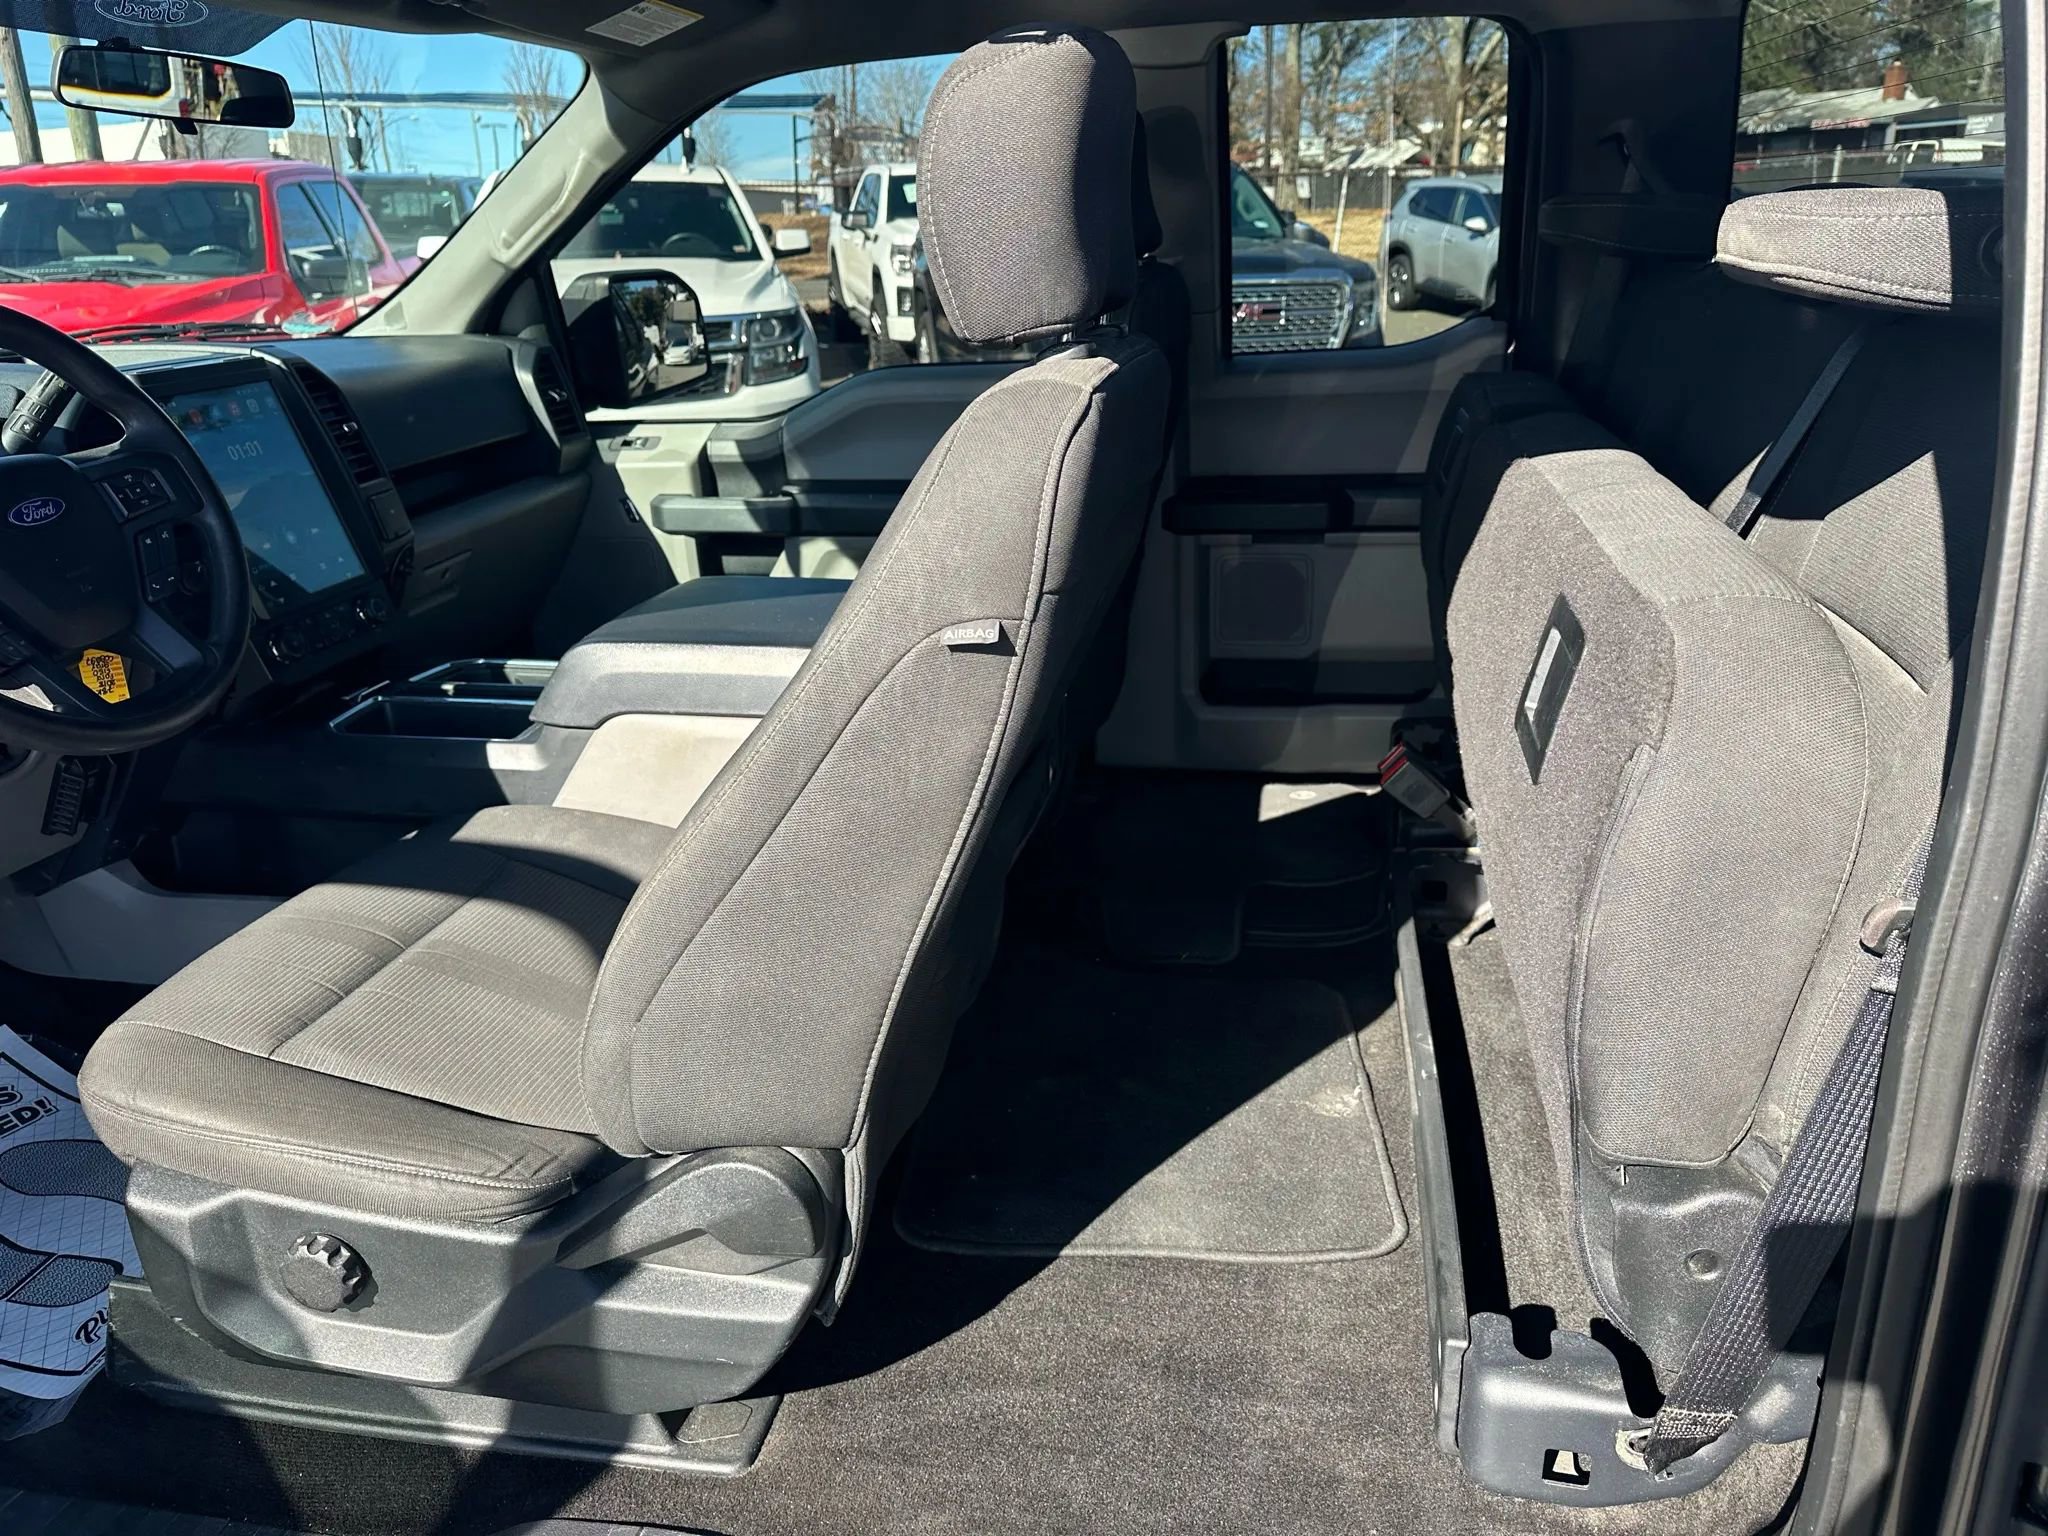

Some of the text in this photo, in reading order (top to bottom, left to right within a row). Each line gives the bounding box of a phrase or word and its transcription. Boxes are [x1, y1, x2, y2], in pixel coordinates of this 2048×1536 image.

[227, 440, 263, 460] 01:01
[22, 500, 56, 521] Ford
[943, 628, 995, 640] AIRBAG
